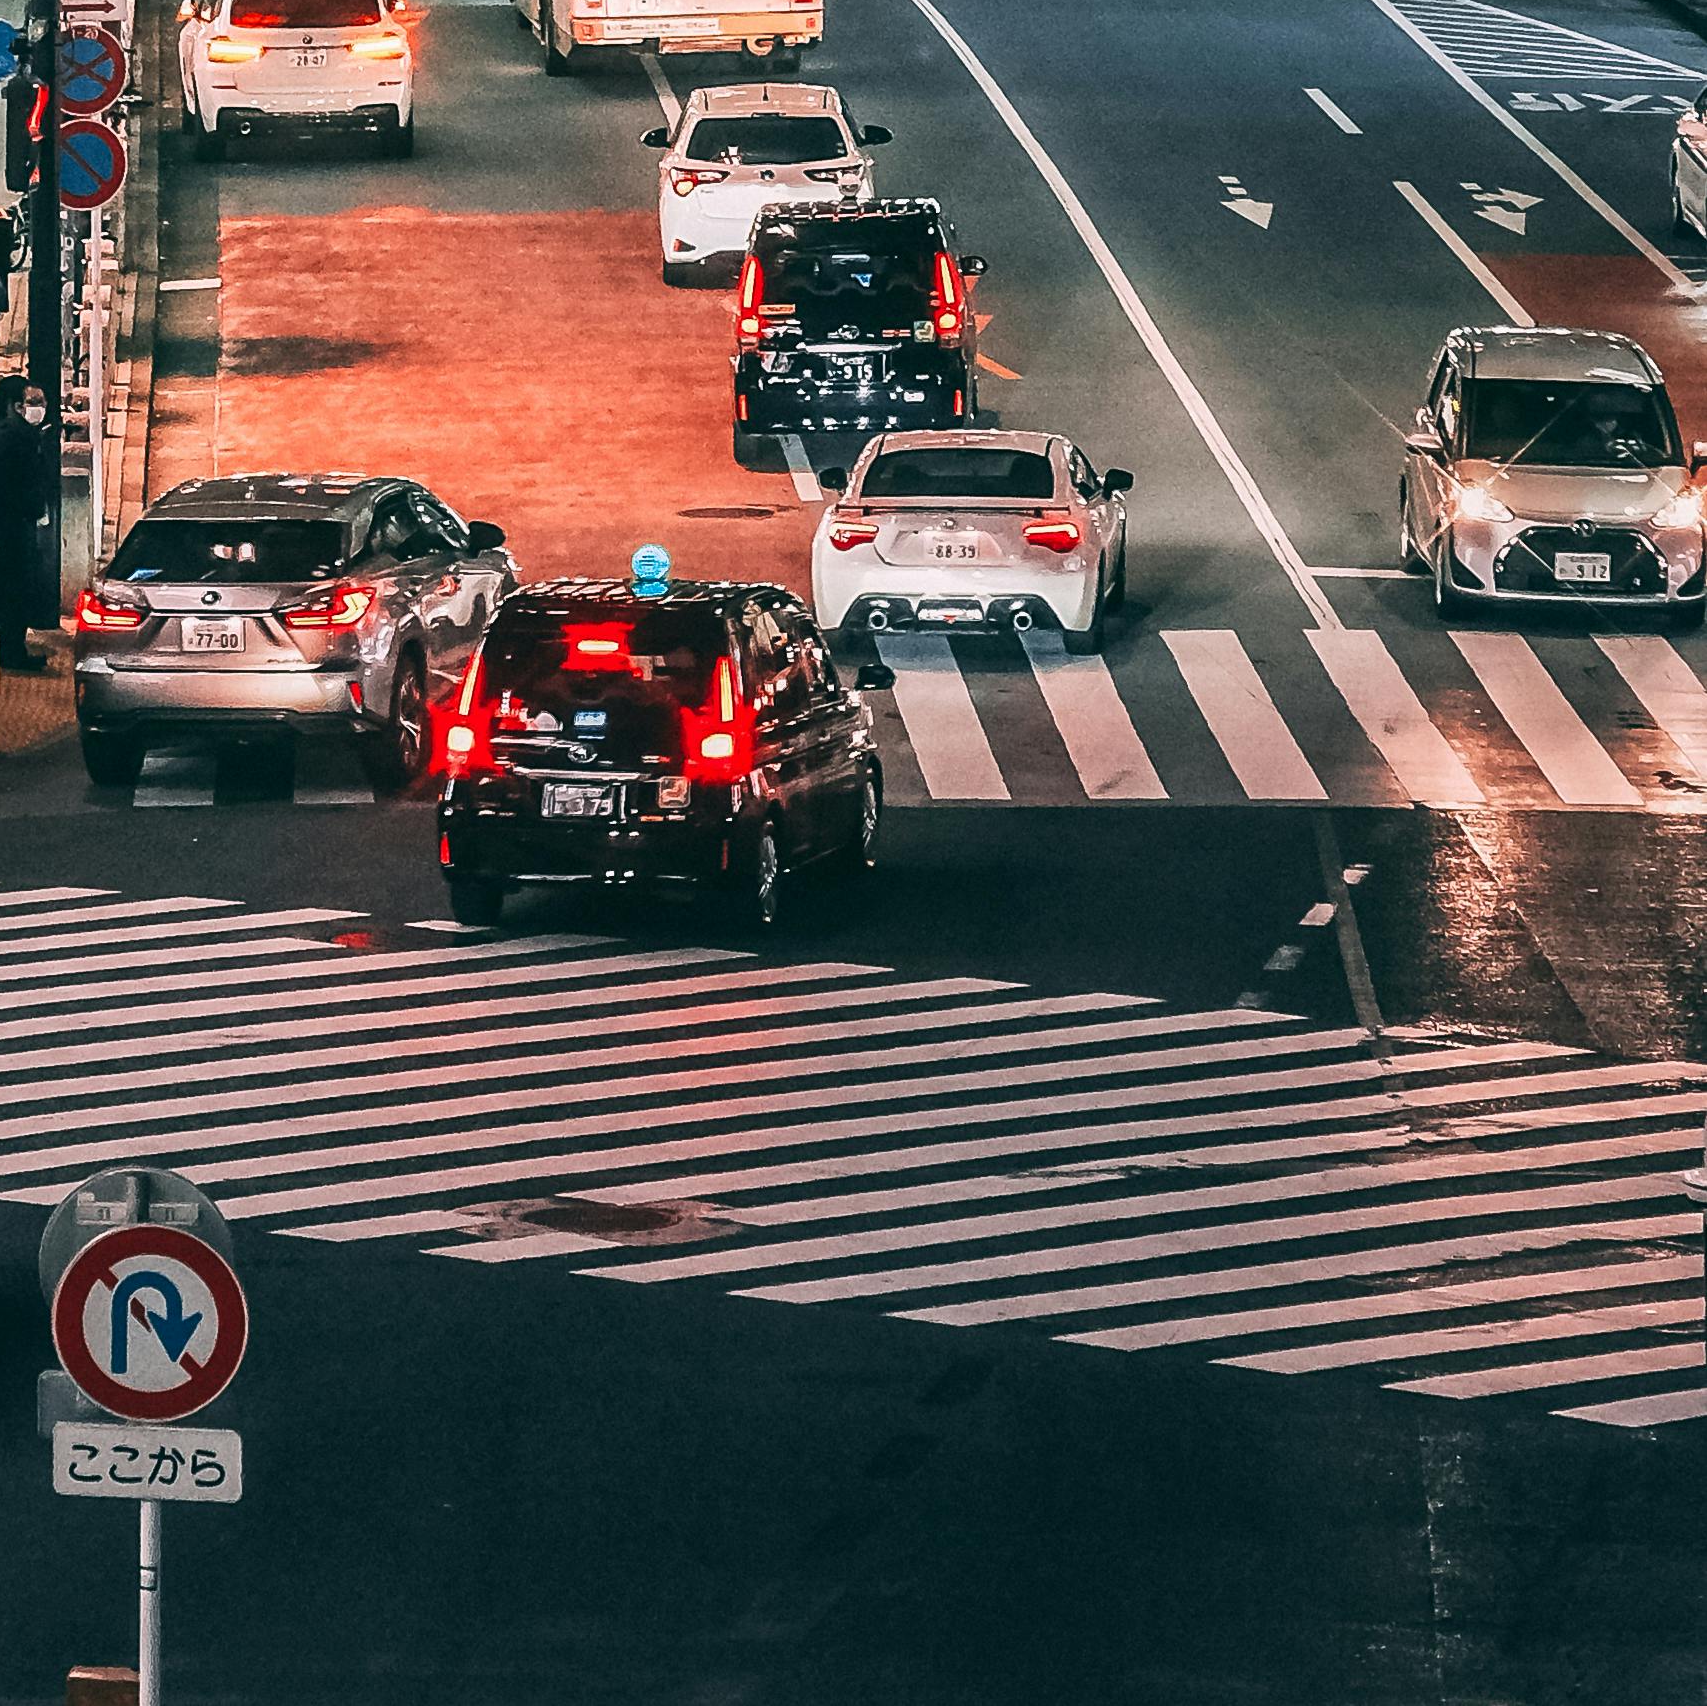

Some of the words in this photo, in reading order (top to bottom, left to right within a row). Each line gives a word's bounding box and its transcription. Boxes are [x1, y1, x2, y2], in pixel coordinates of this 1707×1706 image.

[196, 633, 239, 649] 77-00
[67, 1440, 228, 1489] ここから
